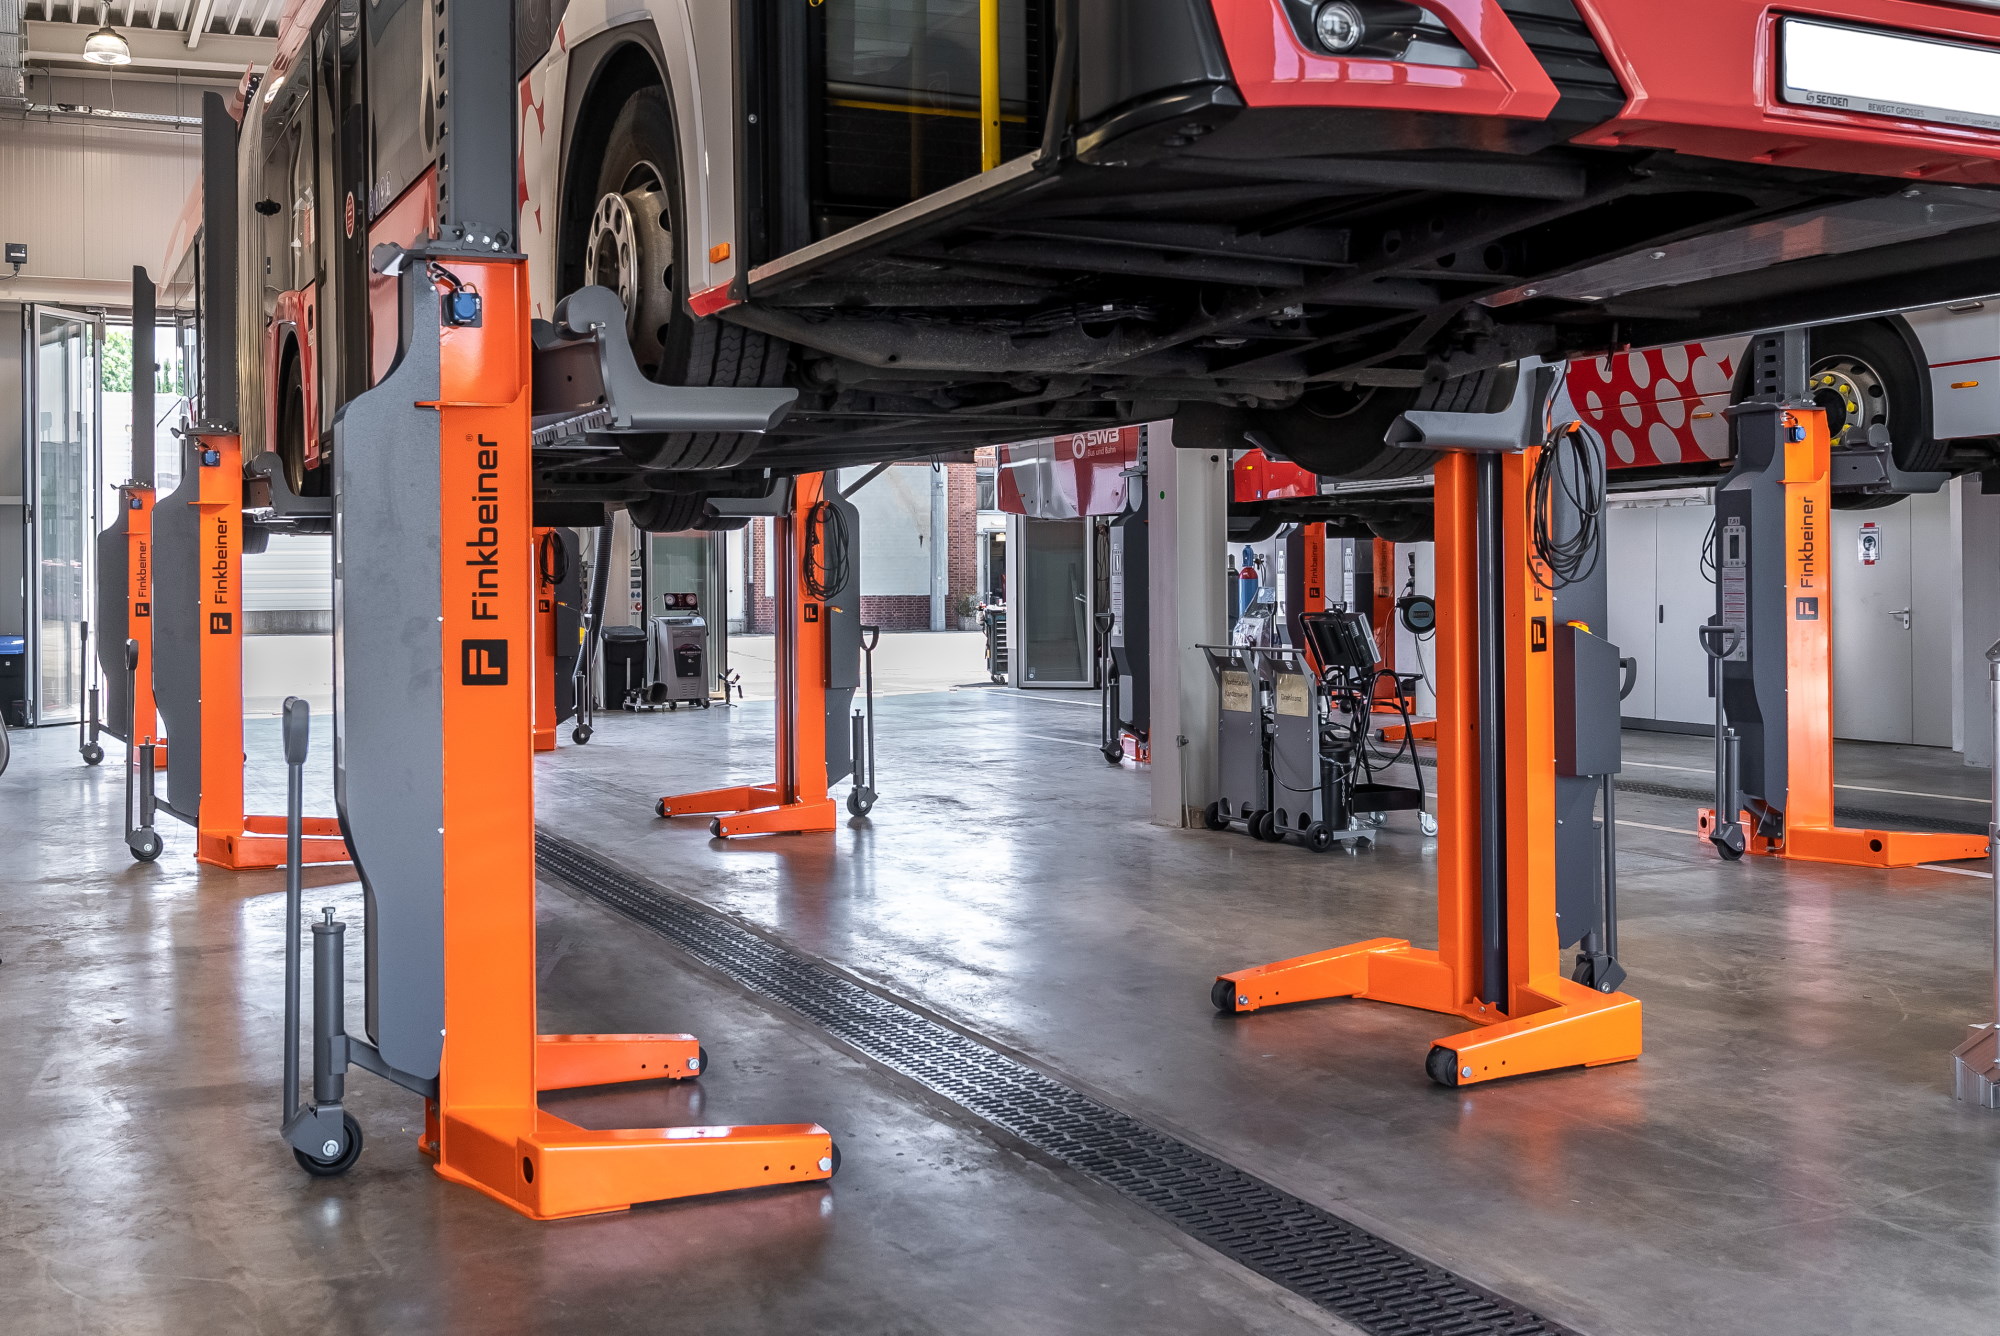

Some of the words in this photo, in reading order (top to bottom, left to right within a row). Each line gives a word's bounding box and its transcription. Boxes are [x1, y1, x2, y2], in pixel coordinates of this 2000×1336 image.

[1816, 94, 1848, 107] SENDEN
[1868, 103, 1894, 113] BEWEGT
[1087, 429, 1119, 446] SWB
[212, 517, 228, 605] Finkbeiner
[466, 433, 499, 621] Finkbeiner
[1798, 497, 1813, 588] Finkbeiner
[136, 541, 147, 598] Finkbeiner
